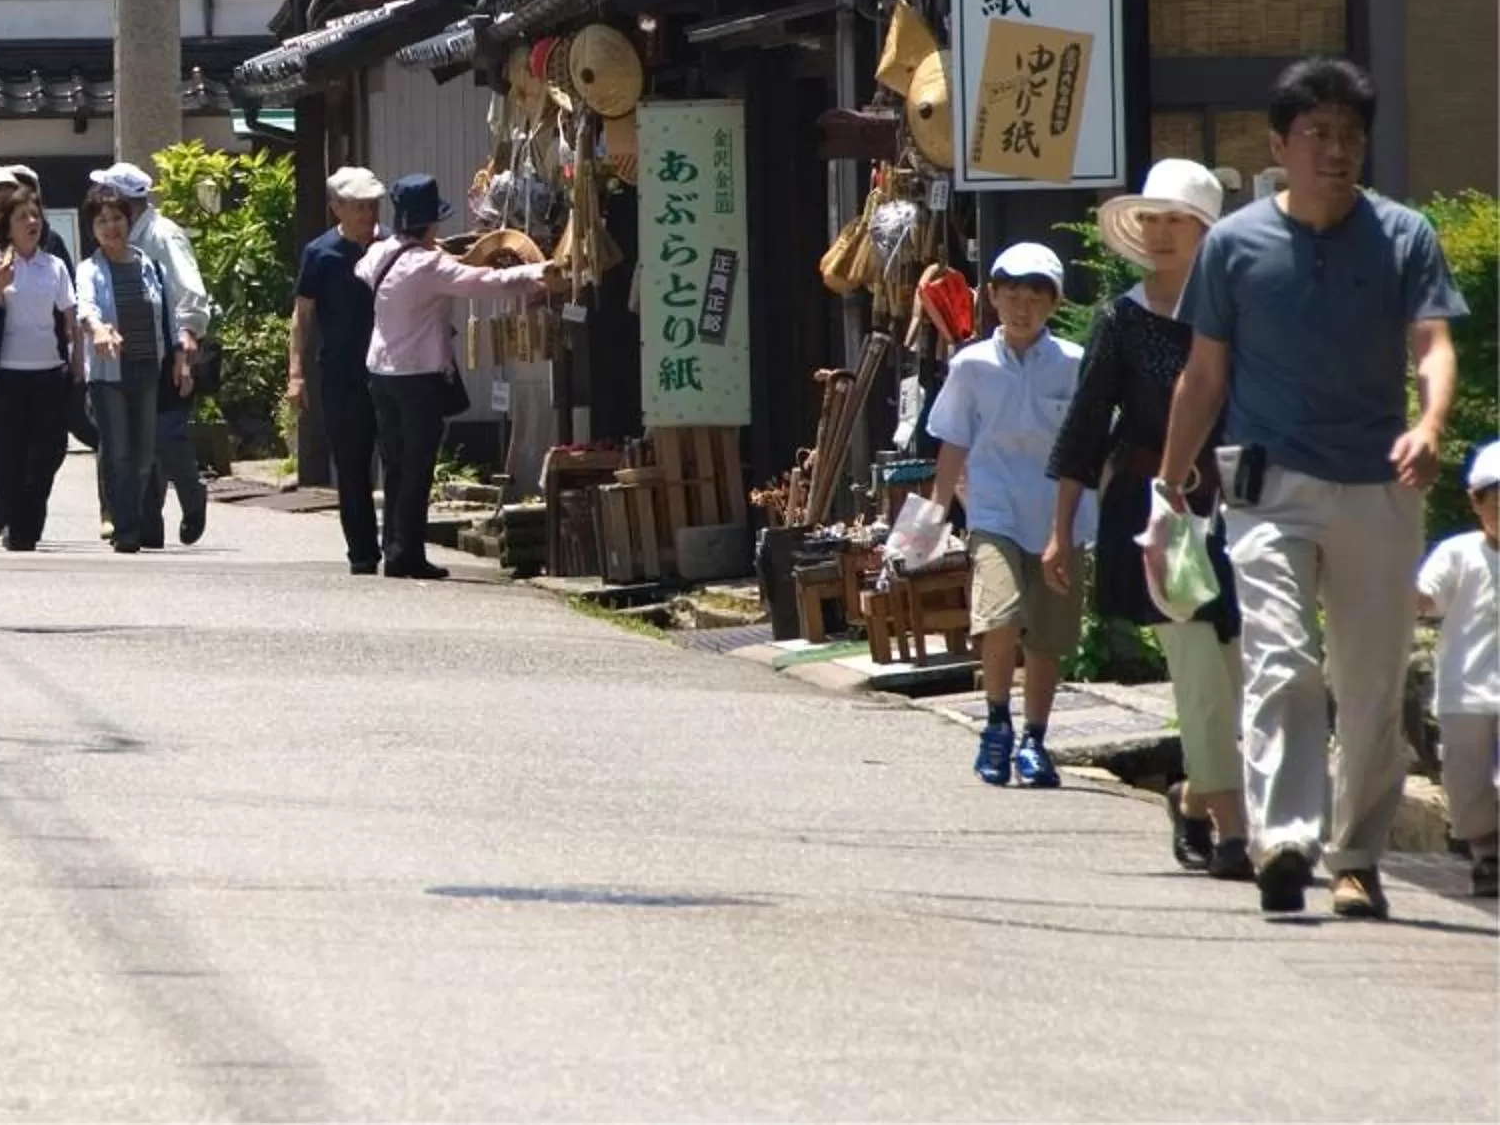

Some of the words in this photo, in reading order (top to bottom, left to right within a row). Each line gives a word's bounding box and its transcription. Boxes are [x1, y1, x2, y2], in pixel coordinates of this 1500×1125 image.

[655, 149, 704, 391] あぶらとり紙
